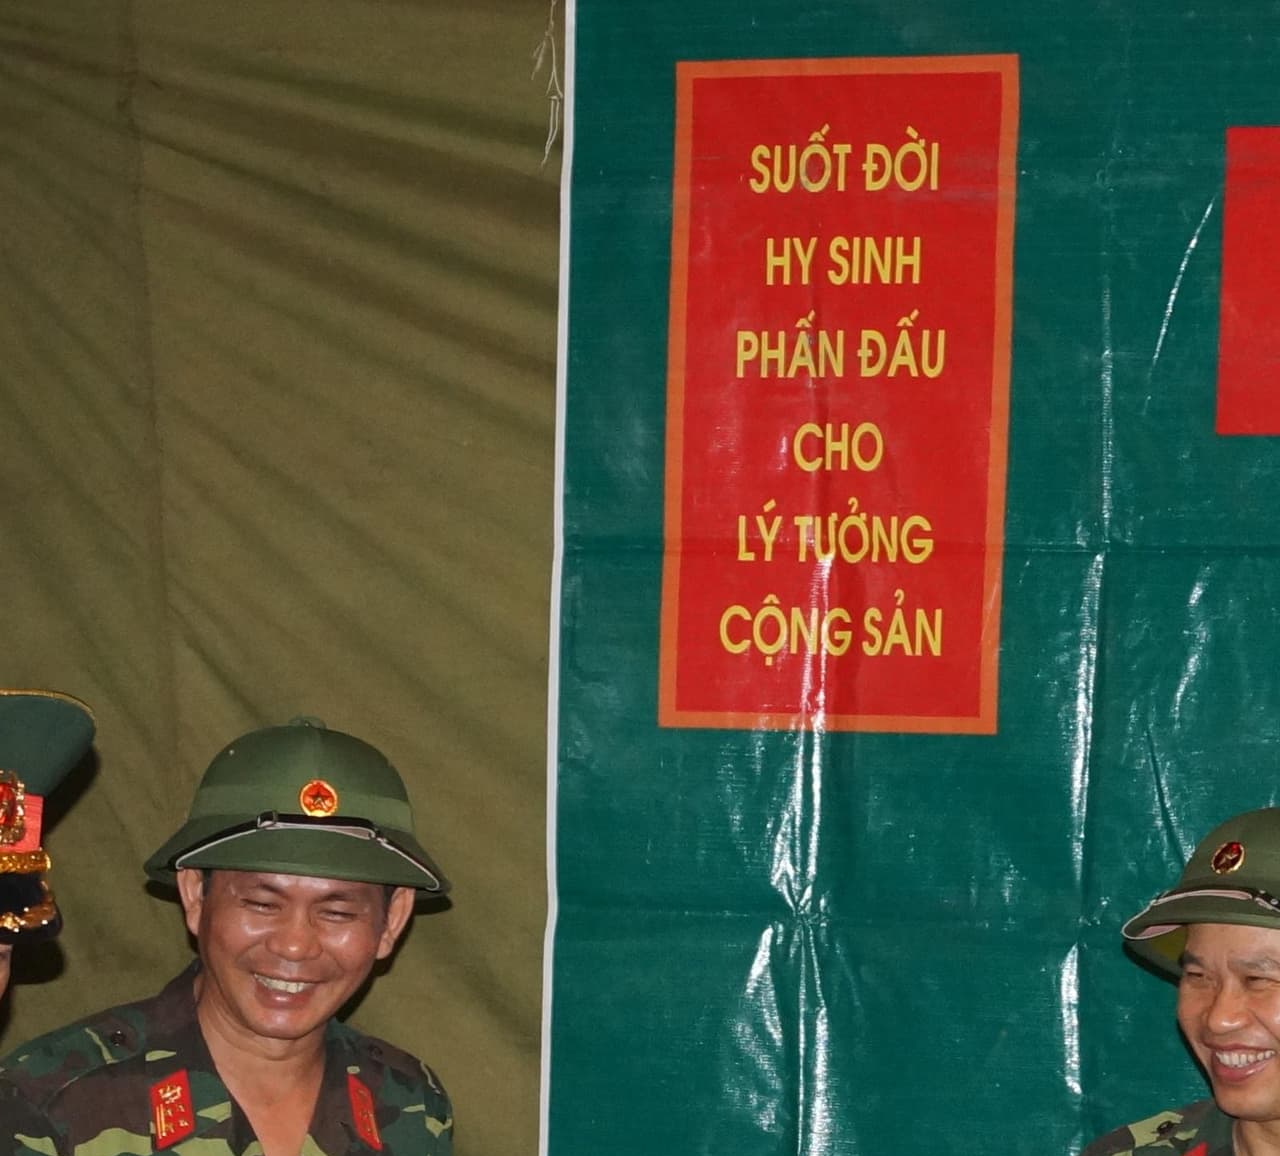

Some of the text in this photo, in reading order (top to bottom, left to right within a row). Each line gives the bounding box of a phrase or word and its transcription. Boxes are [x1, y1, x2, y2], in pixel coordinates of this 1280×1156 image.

[749, 124, 940, 194] SUỐT ĐỜI
[765, 234, 921, 286] HY SINH
[735, 308, 947, 379] PHẤN ĐẤU
[793, 421, 884, 474] CHO
[737, 496, 934, 565] LÝ TƯỞNG
[719, 589, 943, 667] CỘNG SẢN
